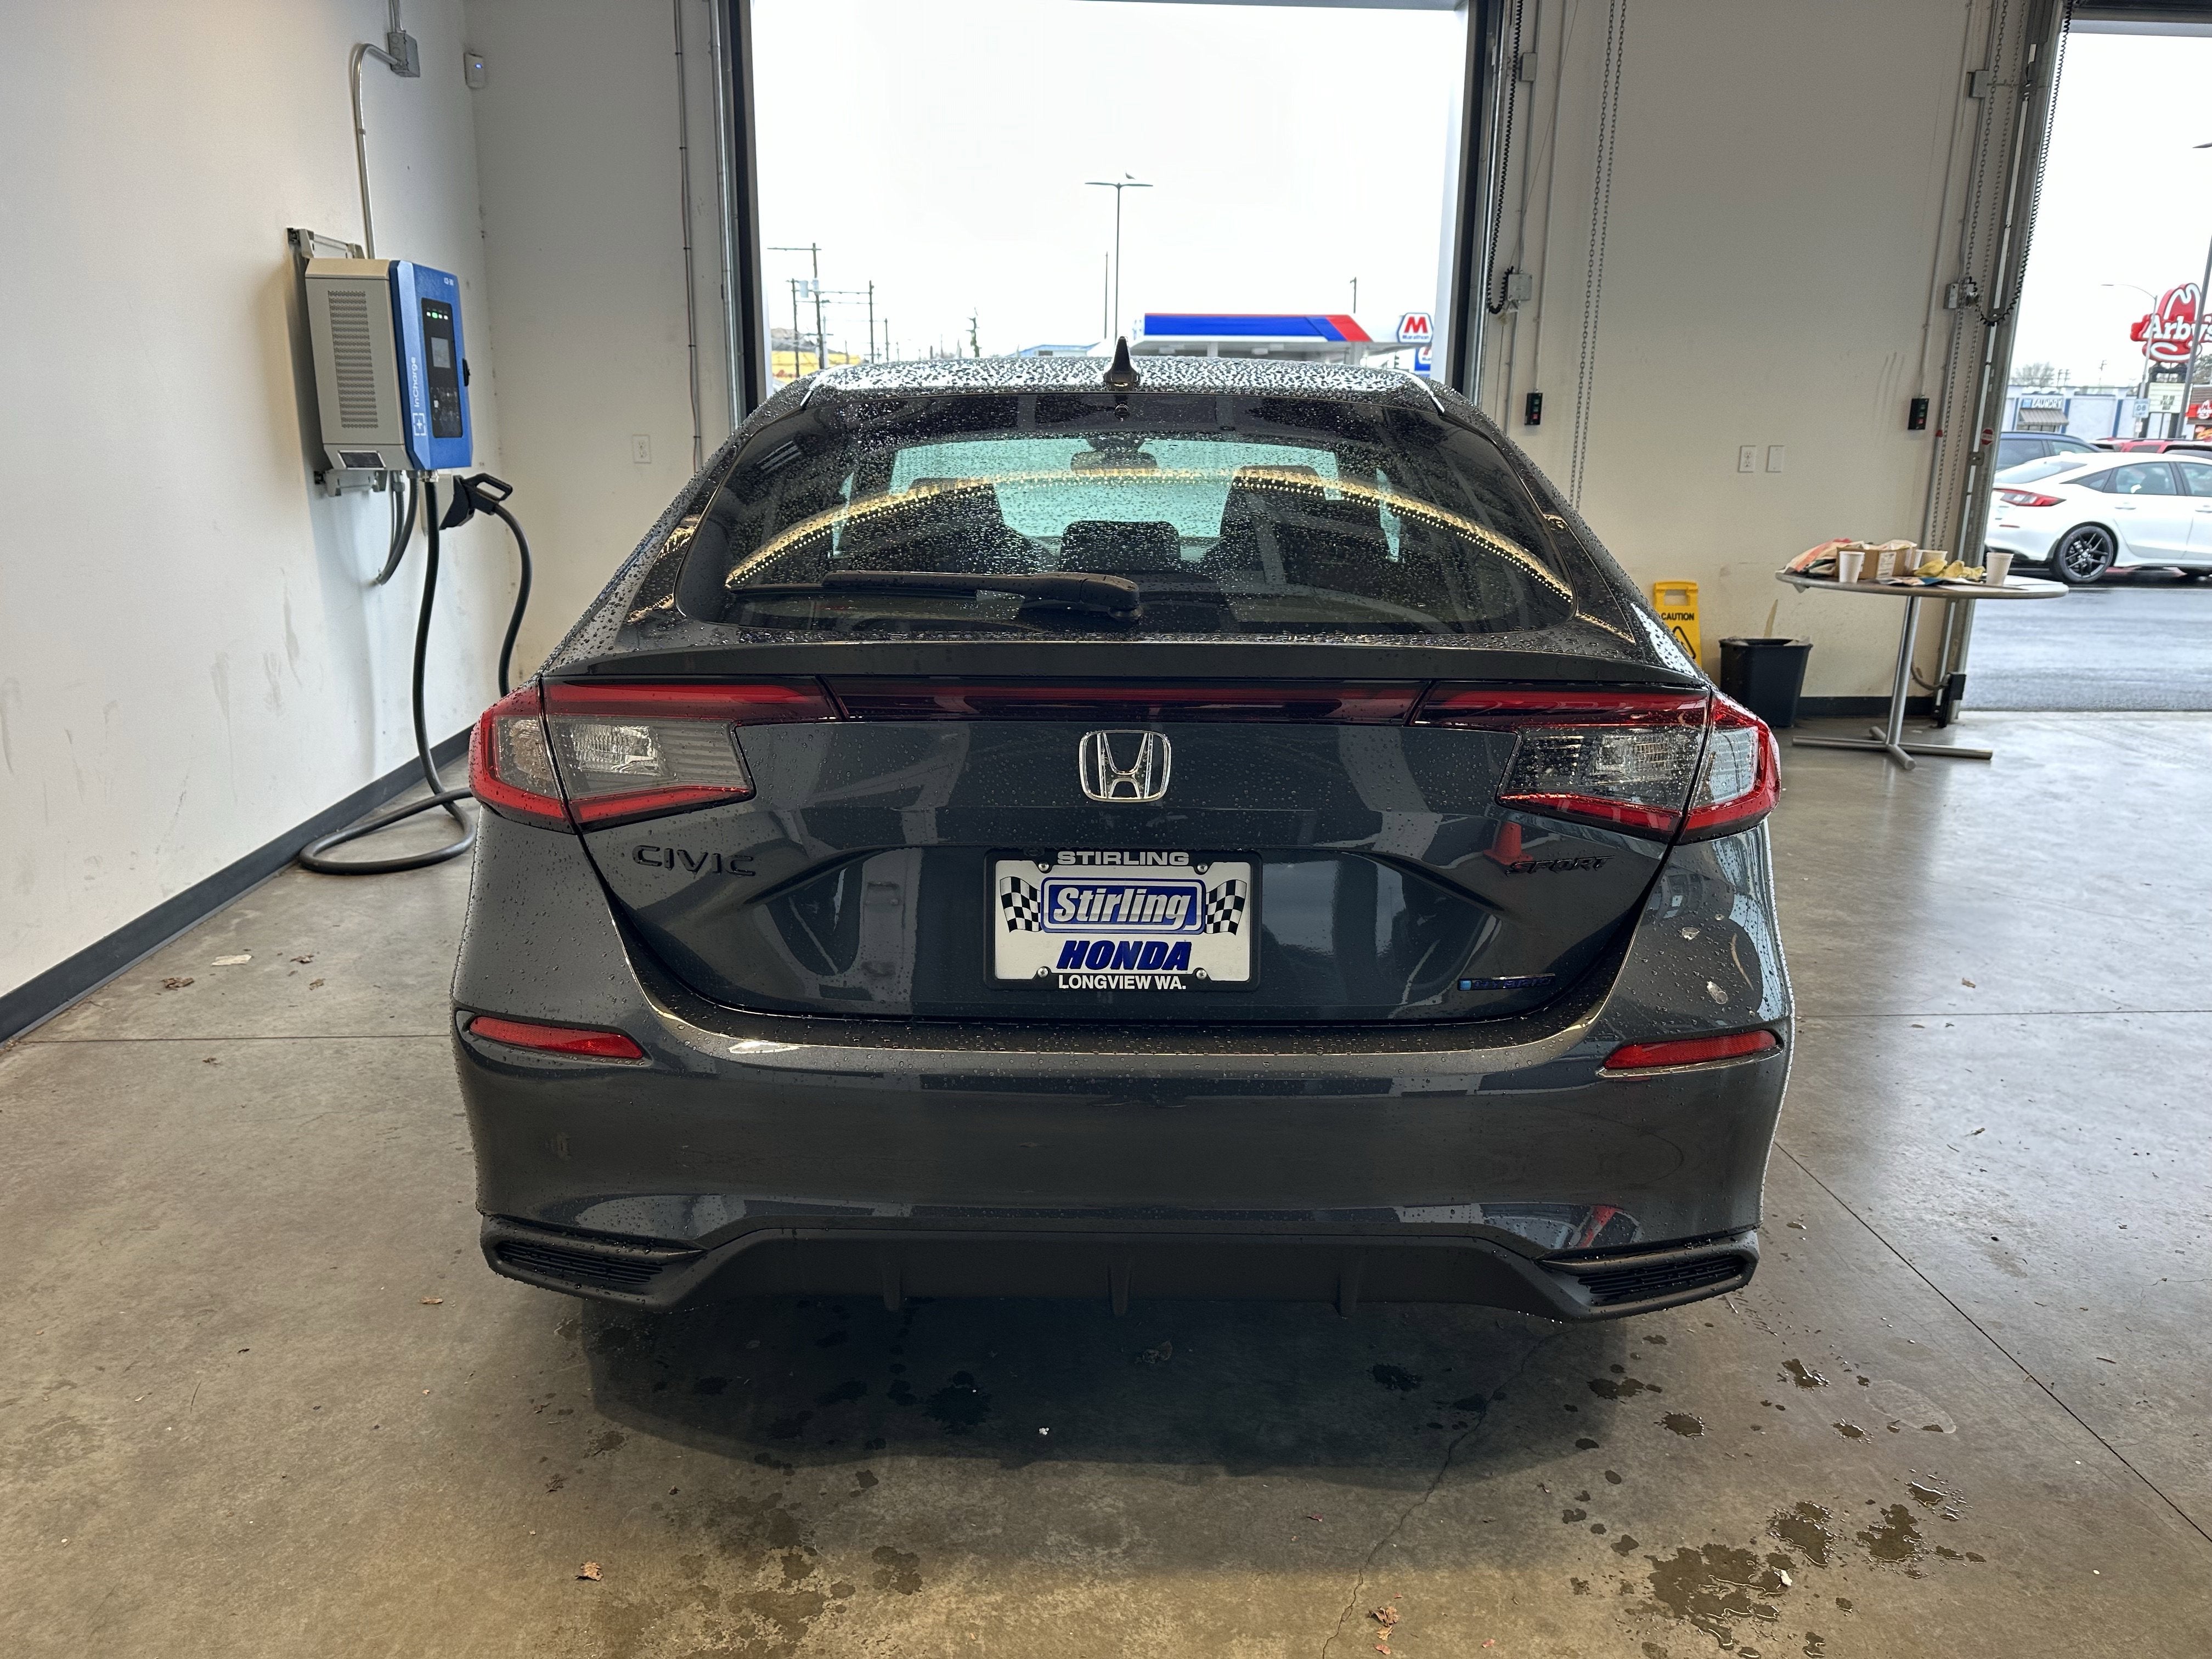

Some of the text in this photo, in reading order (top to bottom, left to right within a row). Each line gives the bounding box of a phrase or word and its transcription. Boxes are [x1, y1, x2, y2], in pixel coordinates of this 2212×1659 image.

[411, 357, 420, 408] InCharge
[2032, 399, 2062, 408] LAUNDRY
[632, 845, 755, 876] CIVIC
[1058, 851, 1189, 865] STIRLING
[1506, 855, 1615, 876] SPORT
[1054, 887, 1191, 928] Stirling
[1056, 940, 1192, 970] HONDA
[1059, 975, 1186, 990] LONGVIEW WA.
[1474, 977, 1551, 989] HYBRID
